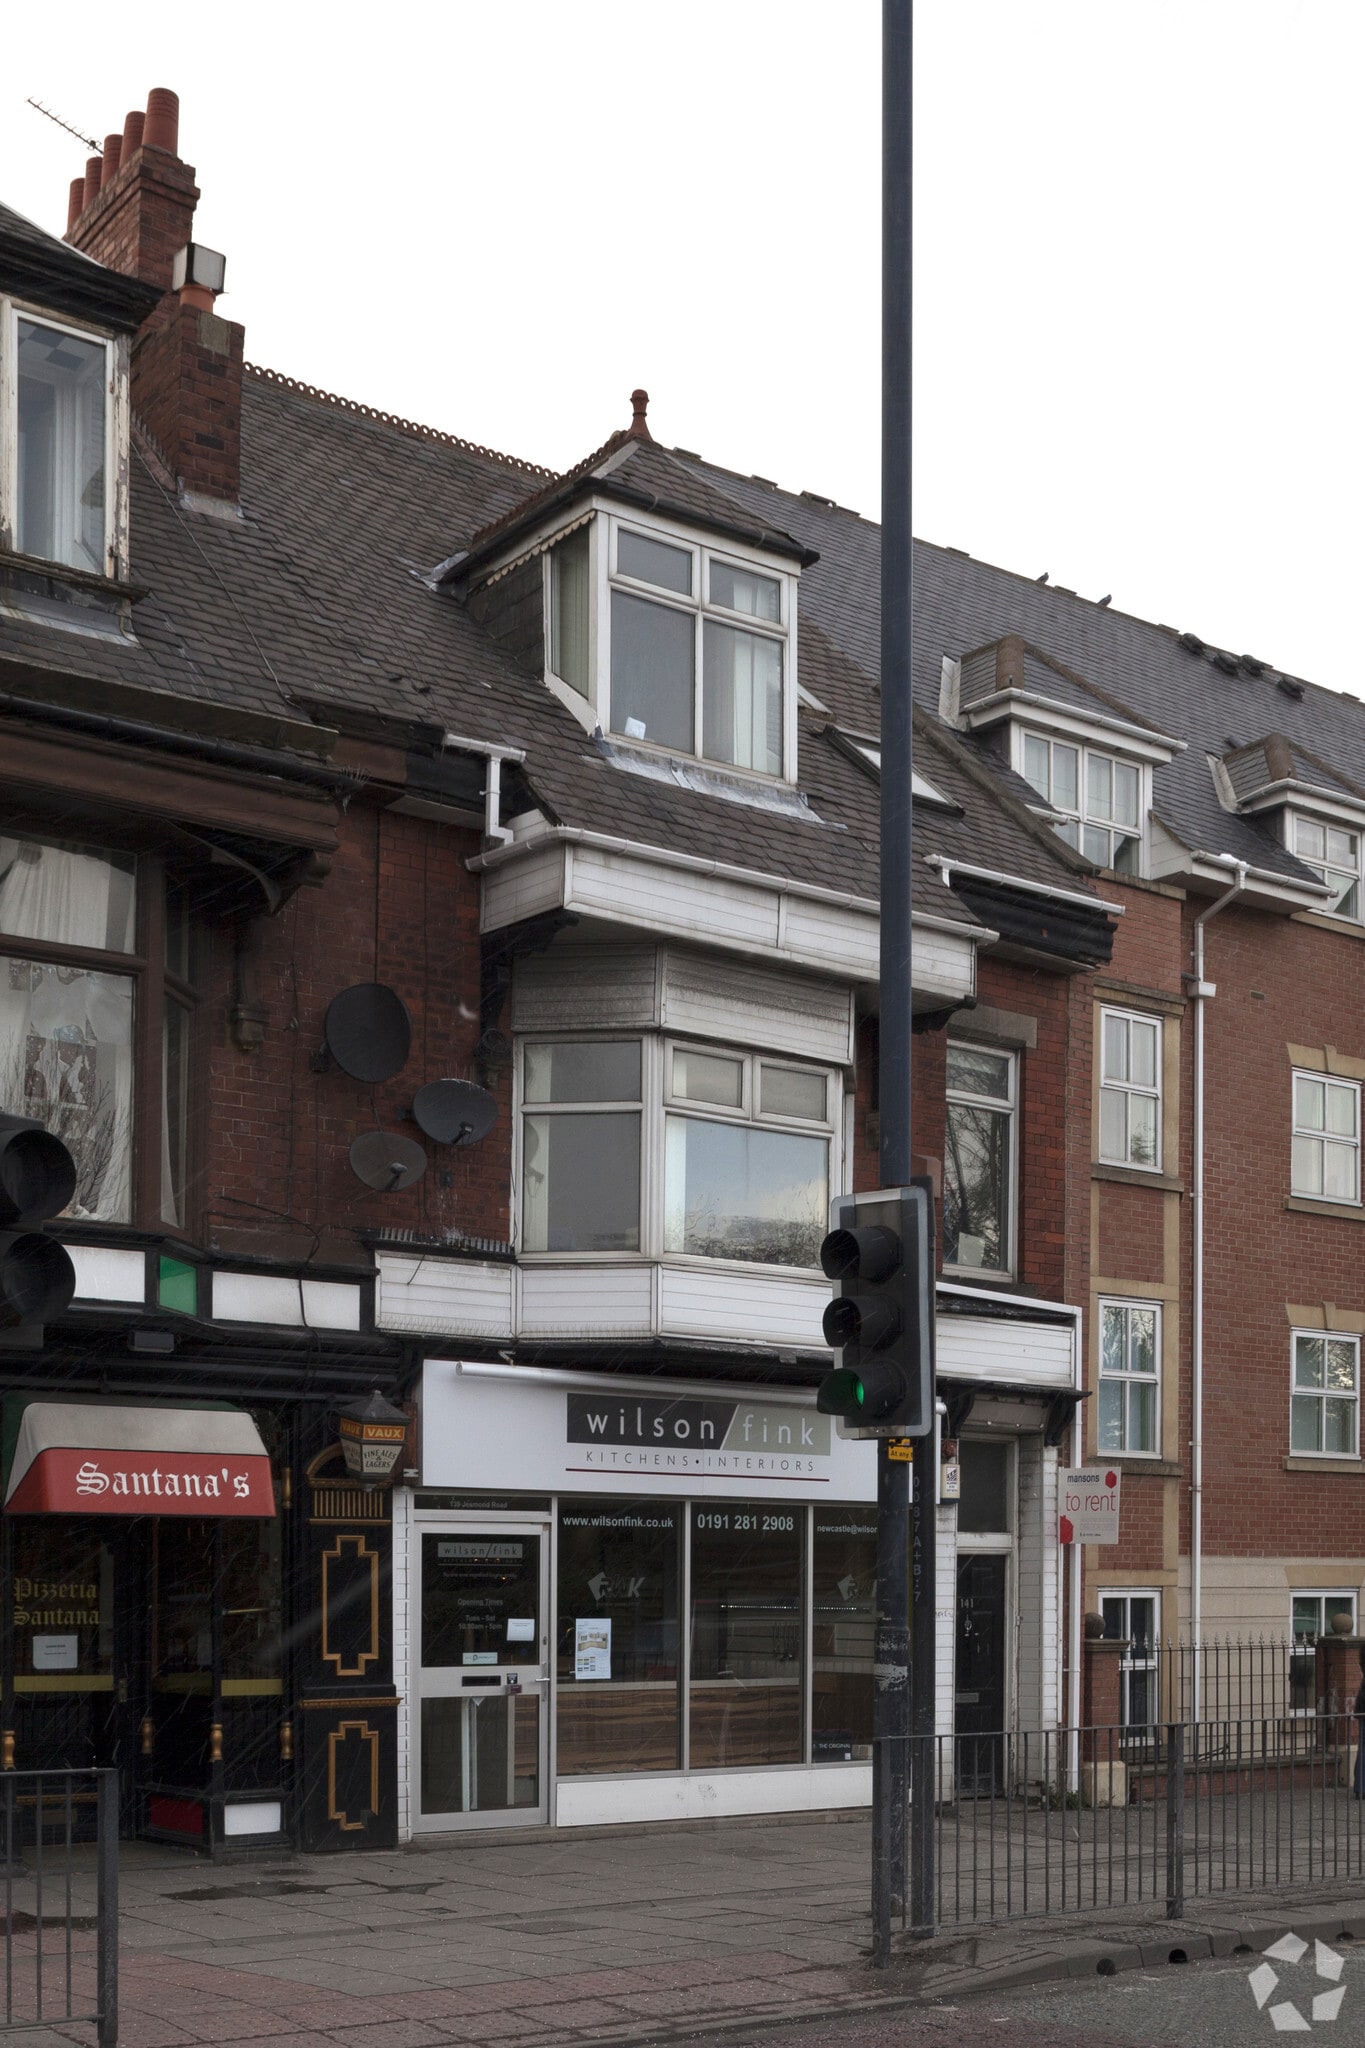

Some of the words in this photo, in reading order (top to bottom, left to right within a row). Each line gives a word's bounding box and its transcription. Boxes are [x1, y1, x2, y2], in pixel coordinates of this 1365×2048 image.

[367, 1428, 401, 1438] VAUX
[364, 1449, 380, 1459] FINE
[381, 1450, 397, 1460] ALES
[365, 1460, 391, 1468] LAGERS
[76, 1461, 250, 1498] Santana's
[1066, 1475, 1100, 1483] mansons
[462, 1500, 490, 1509] Jesmond
[491, 1500, 508, 1509] Road
[1065, 1491, 1081, 1512] to
[1085, 1491, 1117, 1512] rent
[562, 1516, 674, 1528] www.wilsonfink.co.uk
[697, 1513, 730, 1530] 0191
[734, 1515, 758, 1530] 281
[762, 1516, 794, 1531] 2908
[13, 1578, 98, 1602] Pizzeria
[960, 1598, 974, 1609] 141
[14, 1605, 100, 1626] Santana
